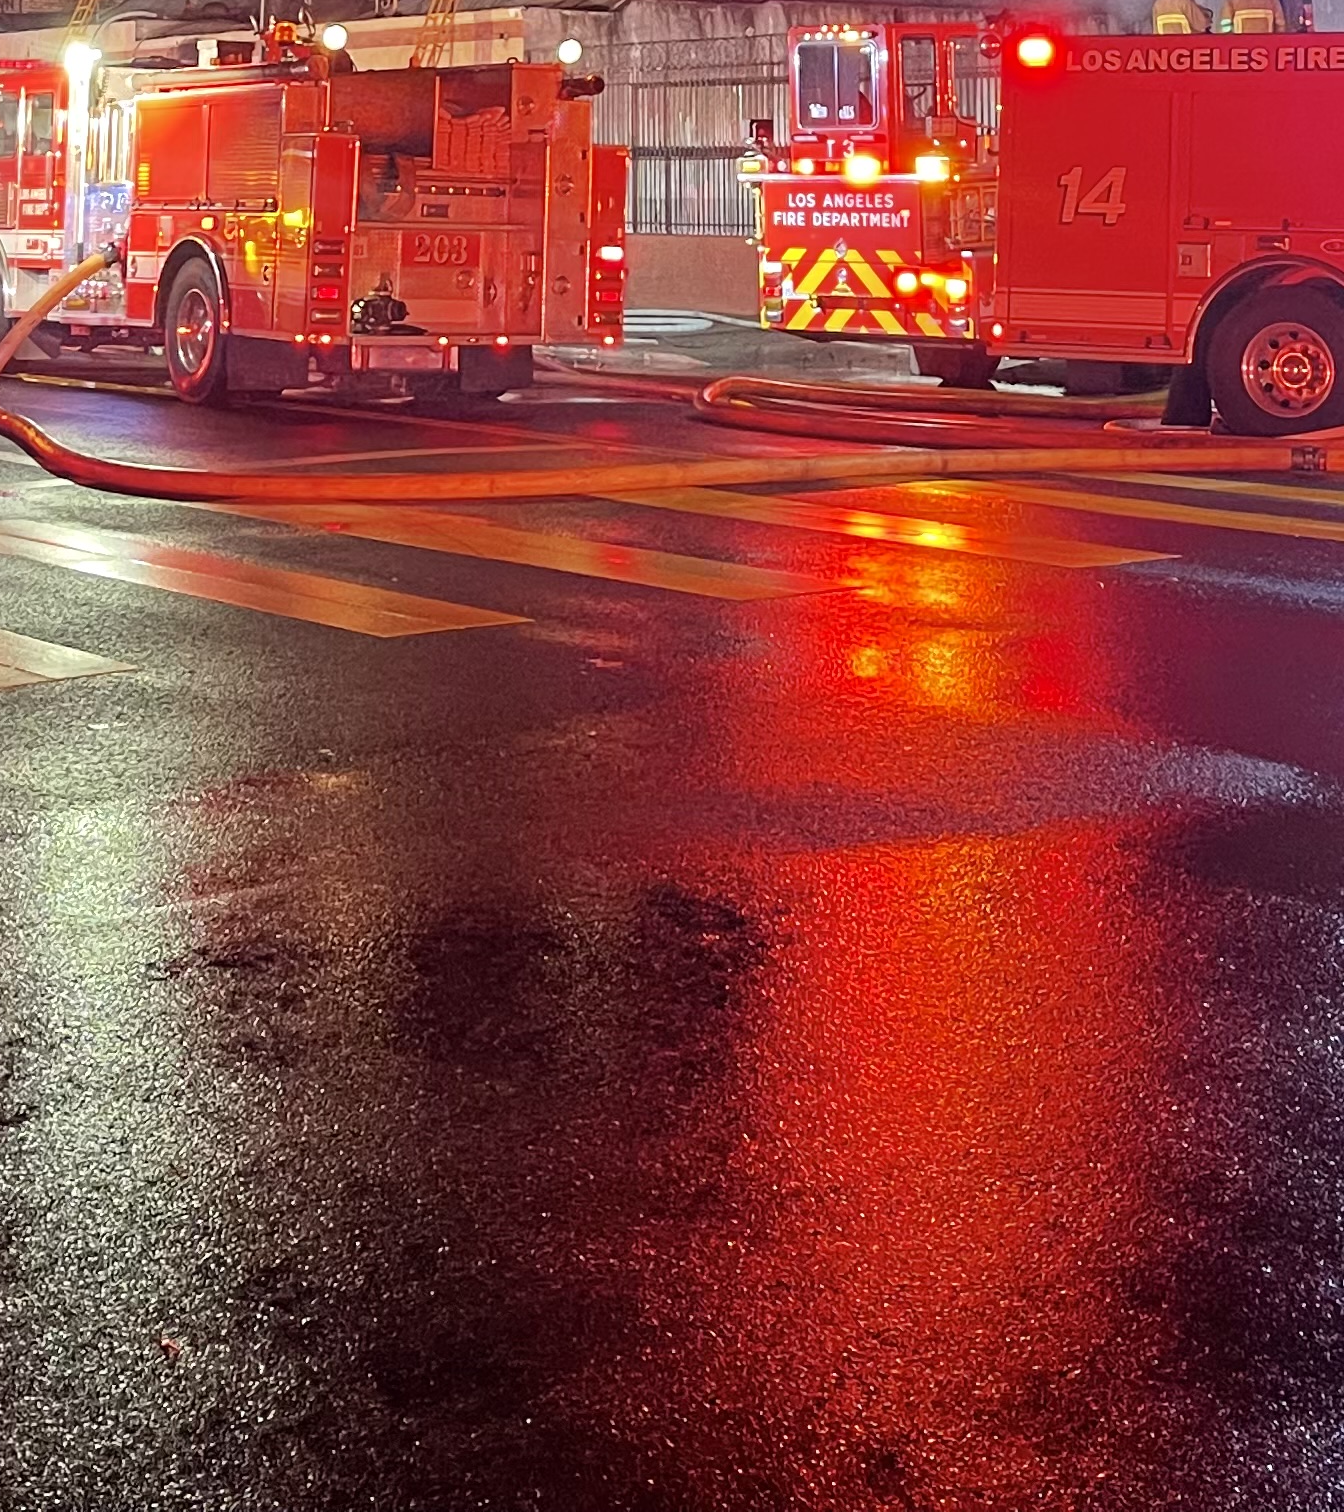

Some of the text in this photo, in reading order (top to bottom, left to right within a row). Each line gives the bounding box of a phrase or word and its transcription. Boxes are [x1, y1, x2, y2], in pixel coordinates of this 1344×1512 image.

[1066, 50, 1122, 73] LOS
[1126, 48, 1269, 73] ANGELES
[788, 193, 895, 209] LOS ANGELES
[1058, 167, 1127, 225] 14
[773, 211, 911, 228] FIRE DEPARTMENT
[414, 233, 468, 264] 203
